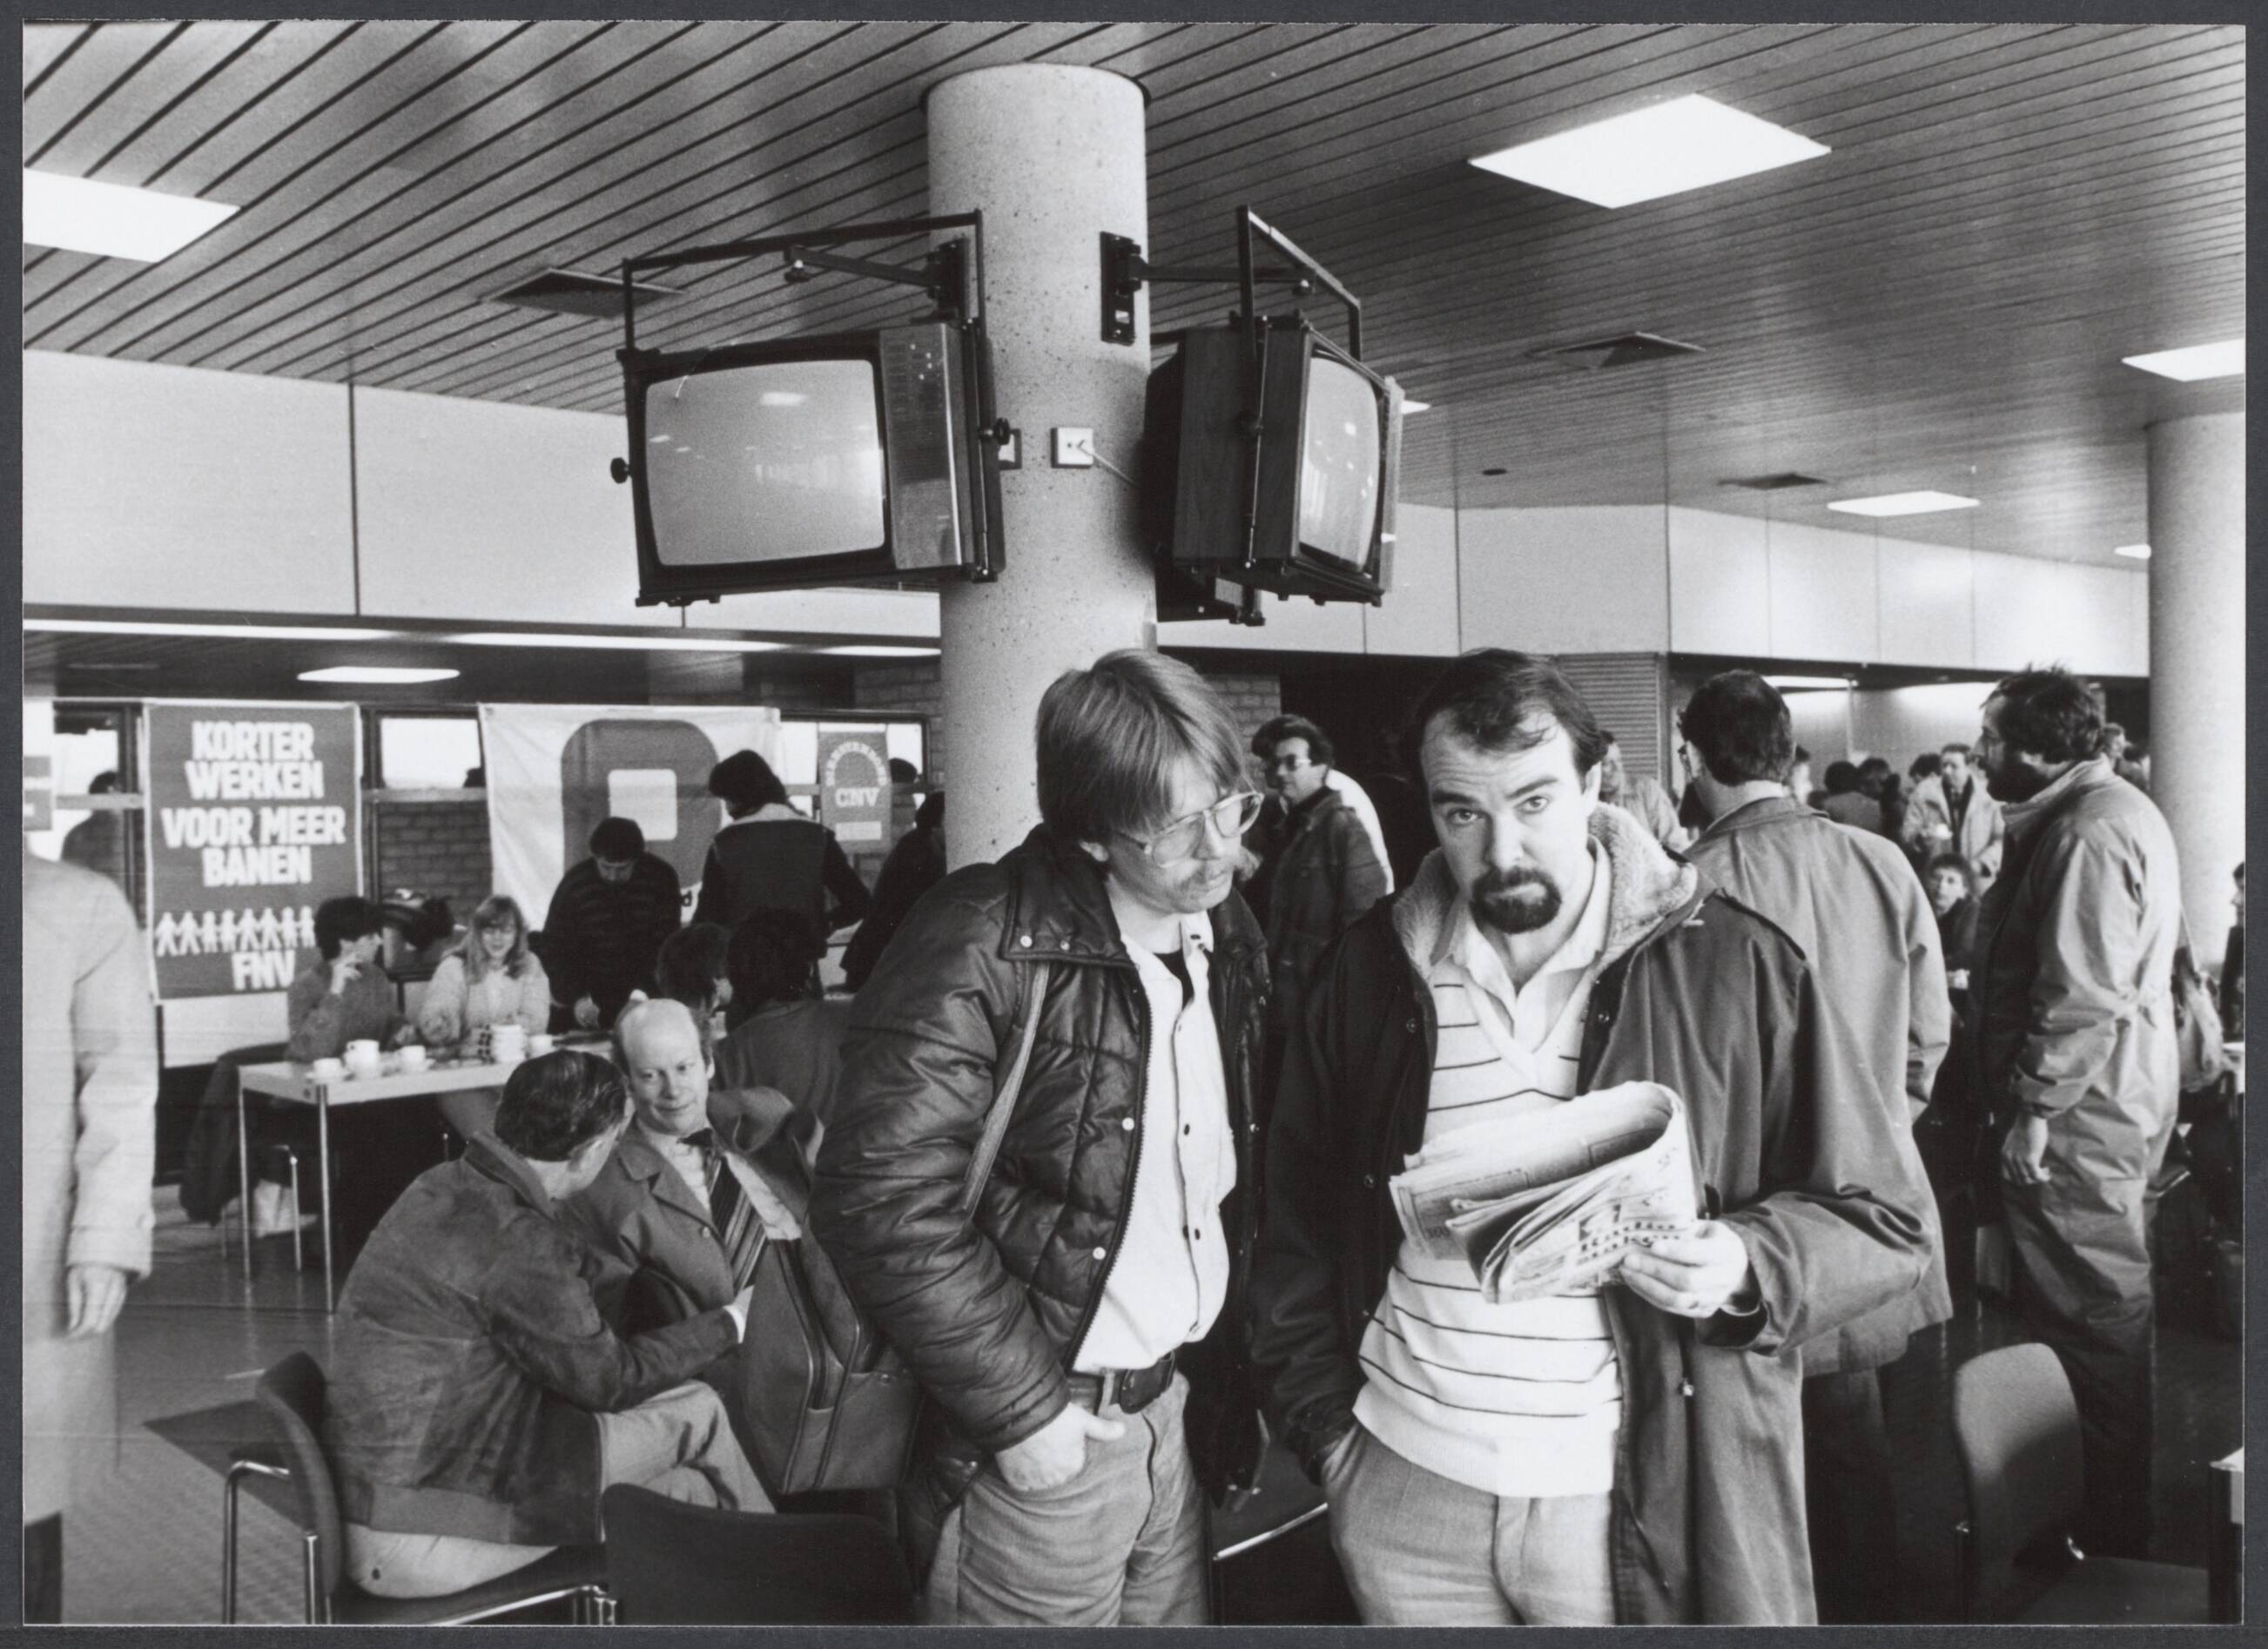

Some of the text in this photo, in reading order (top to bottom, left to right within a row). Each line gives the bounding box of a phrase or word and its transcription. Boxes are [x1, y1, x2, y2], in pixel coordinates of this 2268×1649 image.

[192, 721, 315, 760] KORTER
[185, 760, 325, 799] WERKEN
[836, 787, 880, 807] CNV
[160, 805, 346, 848] VOOR MEER
[202, 845, 312, 886] BANEN
[232, 949, 296, 991] FNV
